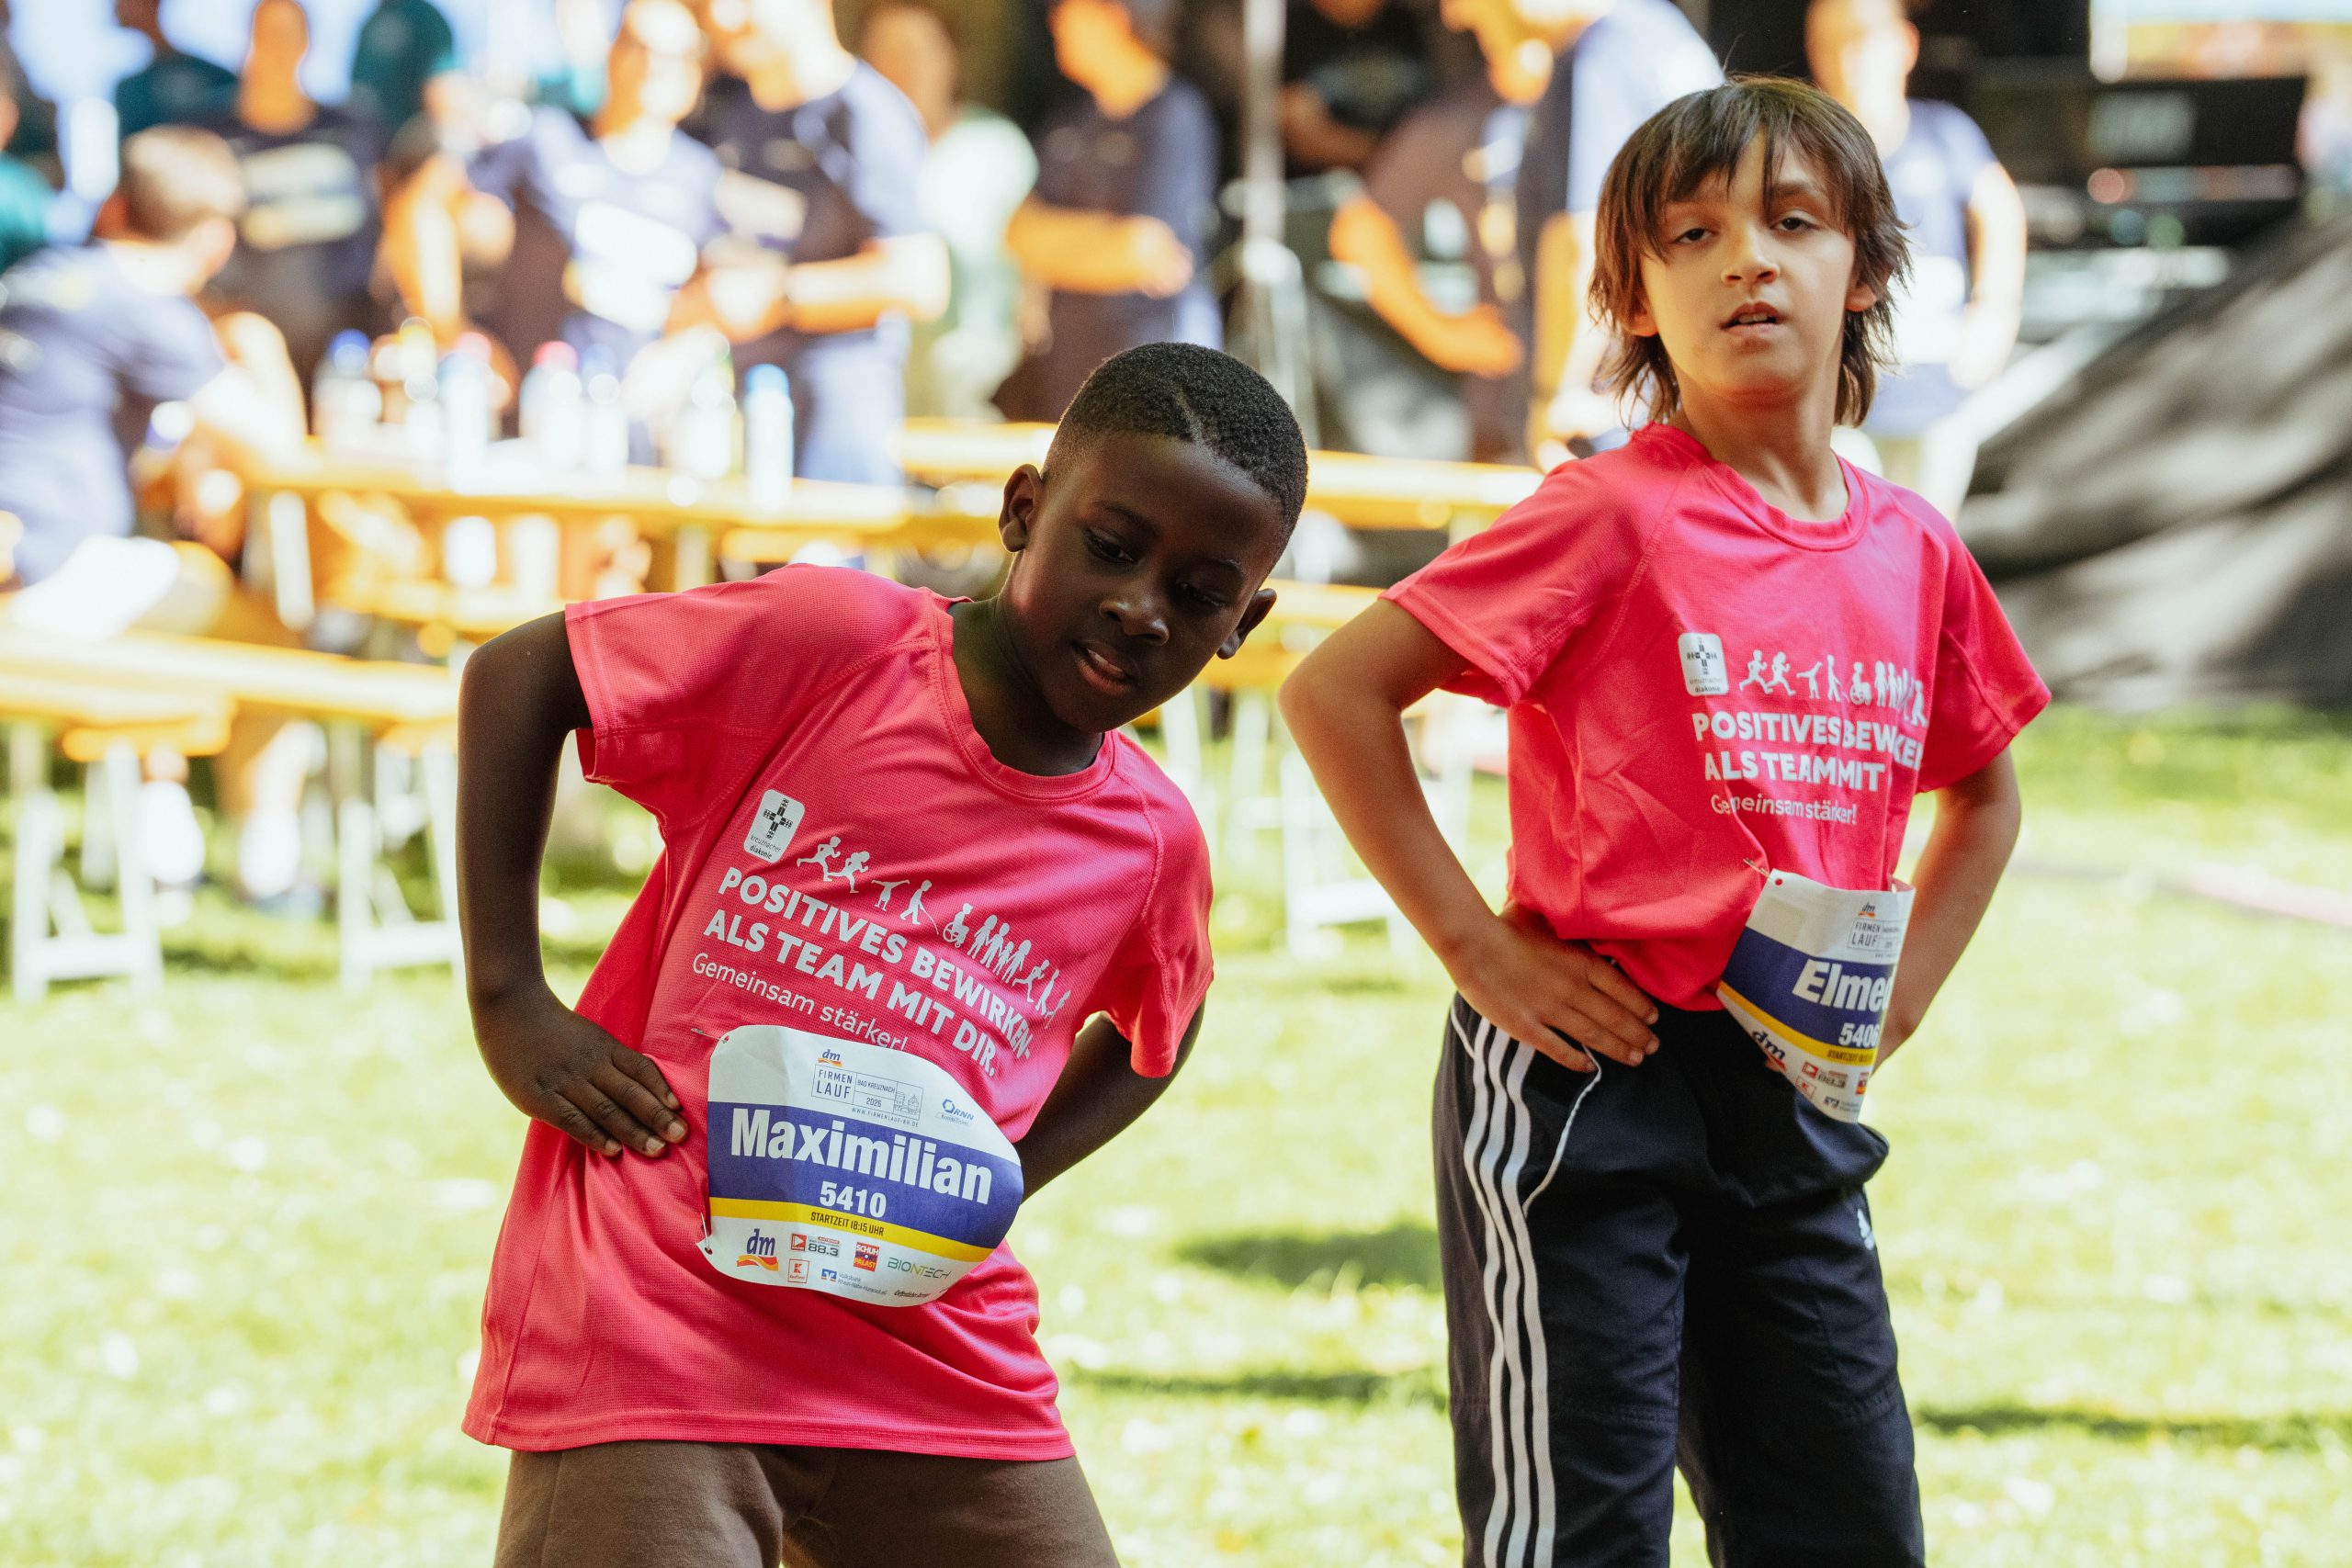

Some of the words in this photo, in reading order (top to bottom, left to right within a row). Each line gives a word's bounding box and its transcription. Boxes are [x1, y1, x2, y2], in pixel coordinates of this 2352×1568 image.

[1692, 710, 1841, 746] POSITIVES
[1842, 719, 1922, 772] BEWKE
[1705, 750, 1758, 781] ALS
[1760, 751, 1837, 785] TEAM
[1838, 758, 1885, 792] MIT
[749, 845, 773, 860] diakonie
[718, 866, 908, 964] POSITIVES
[1851, 932, 1879, 947] LAUF
[693, 953, 815, 1014] Gemeinsam
[704, 909, 769, 953] ALS
[776, 931, 884, 1000] TEAM
[887, 980, 956, 1035] MIT
[952, 1019, 996, 1077] DIR.
[822, 1048, 841, 1061] dm
[817, 1080, 851, 1099] LAUF
[819, 1069, 853, 1084] FIRMEN
[731, 1108, 992, 1205] Maximilian
[820, 1181, 887, 1218] 5410
[810, 1212, 849, 1228] STARTZEIT
[850, 1220, 868, 1233] 18:15
[868, 1224, 885, 1236] UHR
[746, 1228, 776, 1256] dm
[808, 1243, 840, 1257] 88.3
[887, 1257, 952, 1279] BIONTECH
